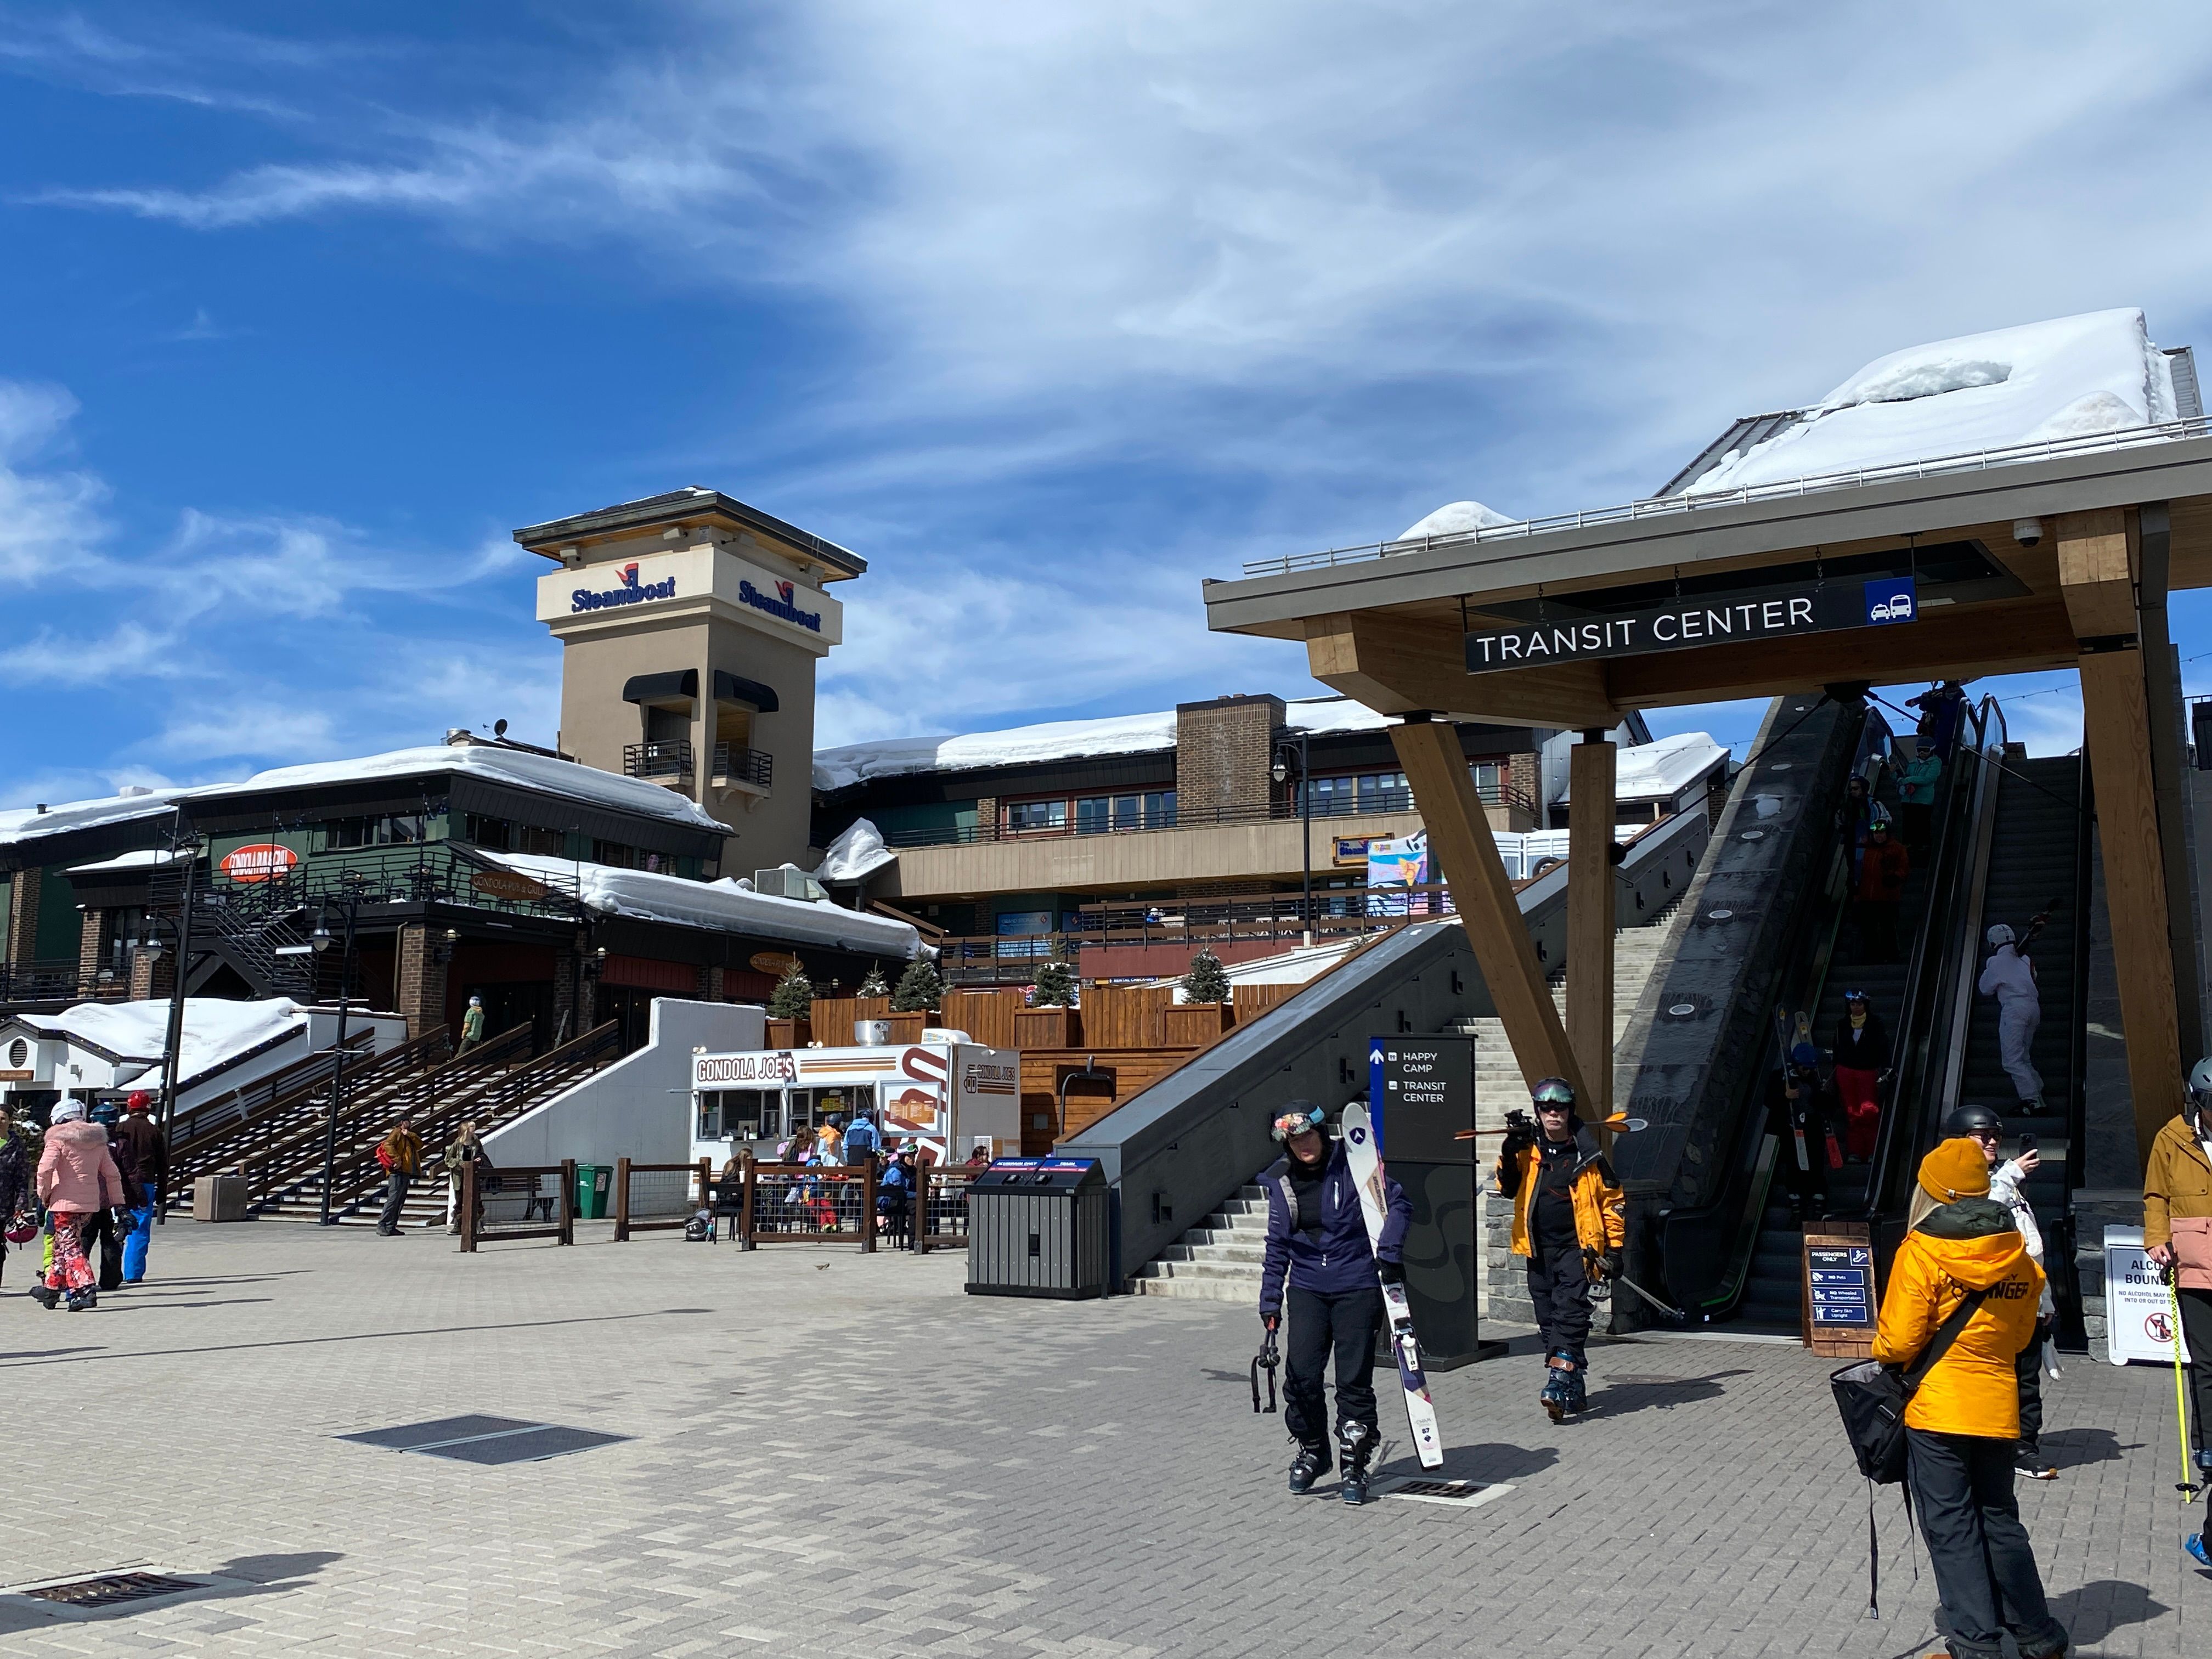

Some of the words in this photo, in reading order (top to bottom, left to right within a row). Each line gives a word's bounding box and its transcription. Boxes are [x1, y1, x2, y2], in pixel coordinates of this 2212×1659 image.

[571, 564, 675, 613] Steamboat
[739, 580, 821, 633] Steamboat
[1476, 619, 1637, 662] TRANSIT
[1653, 597, 1814, 641] CENTER
[229, 851, 256, 876] GONDOLA
[473, 876, 507, 890] GONDOLA
[508, 881, 521, 891] PUB
[527, 884, 544, 895] GRILL
[1403, 1052, 1438, 1061] HAPPY
[697, 1058, 755, 1081] GONDOLA
[758, 1057, 794, 1079] JOE'S
[977, 1064, 1001, 1080] GONDOLA
[1403, 1064, 1433, 1073] CAMP
[1403, 1081, 1447, 1091] TRANSIT
[1403, 1093, 1444, 1103] CENTER
[2125, 1274, 2165, 1285] BOUN
